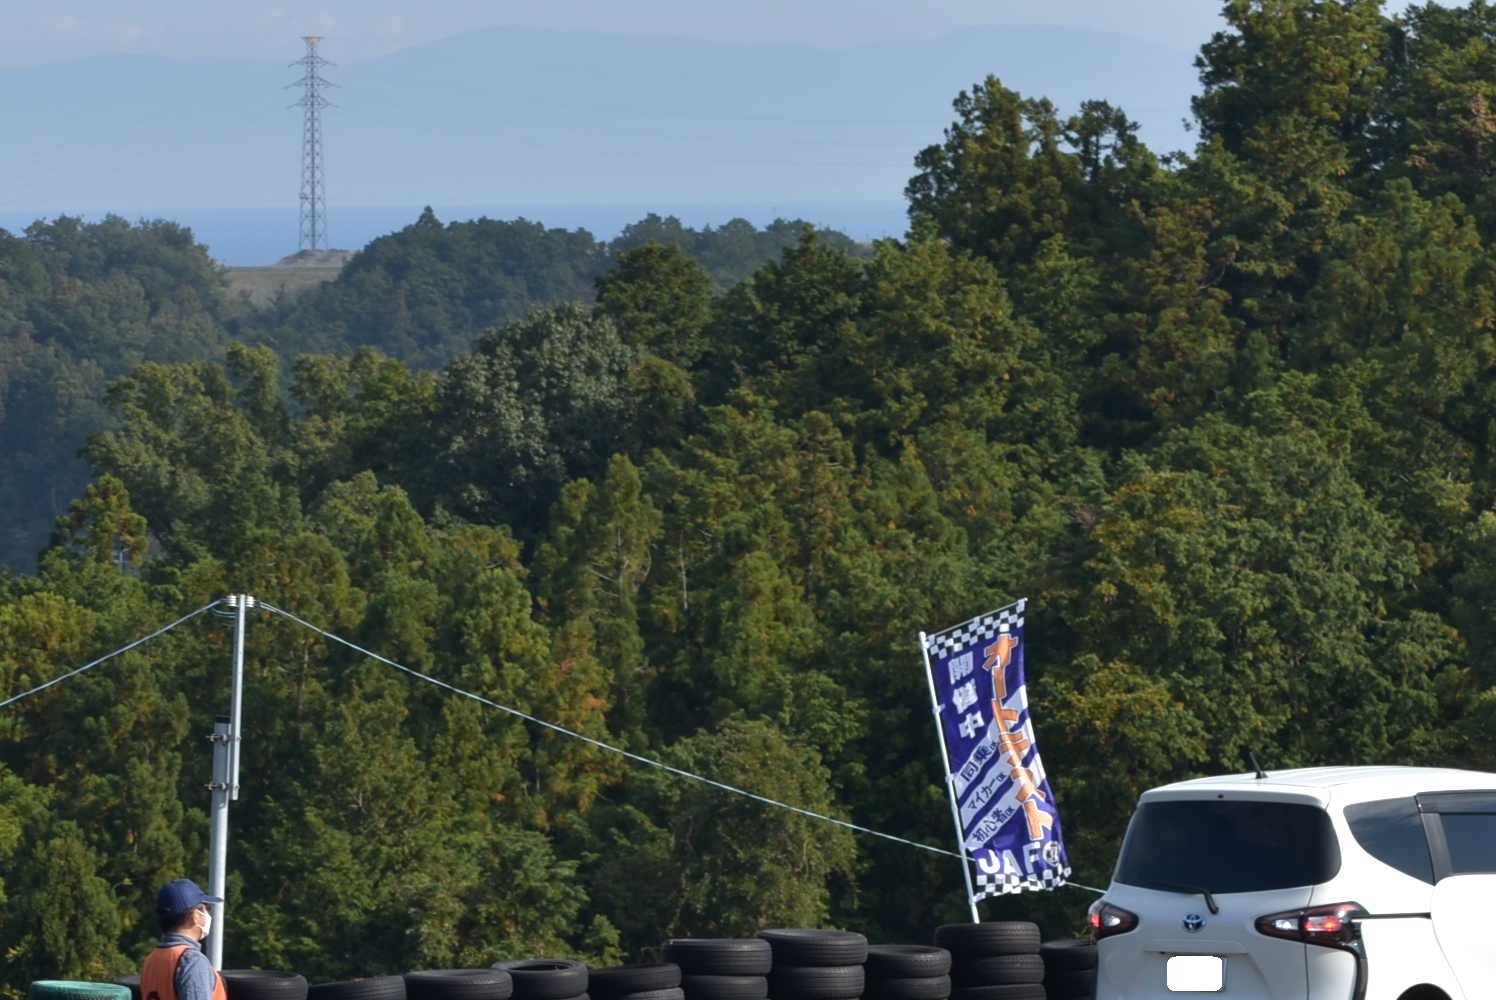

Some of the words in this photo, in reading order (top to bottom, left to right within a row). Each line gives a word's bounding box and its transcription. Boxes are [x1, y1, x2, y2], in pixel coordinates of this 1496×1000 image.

[948, 651, 985, 739] 開催中
[981, 633, 1053, 841] オートテスト
[978, 841, 1041, 877] JAF
